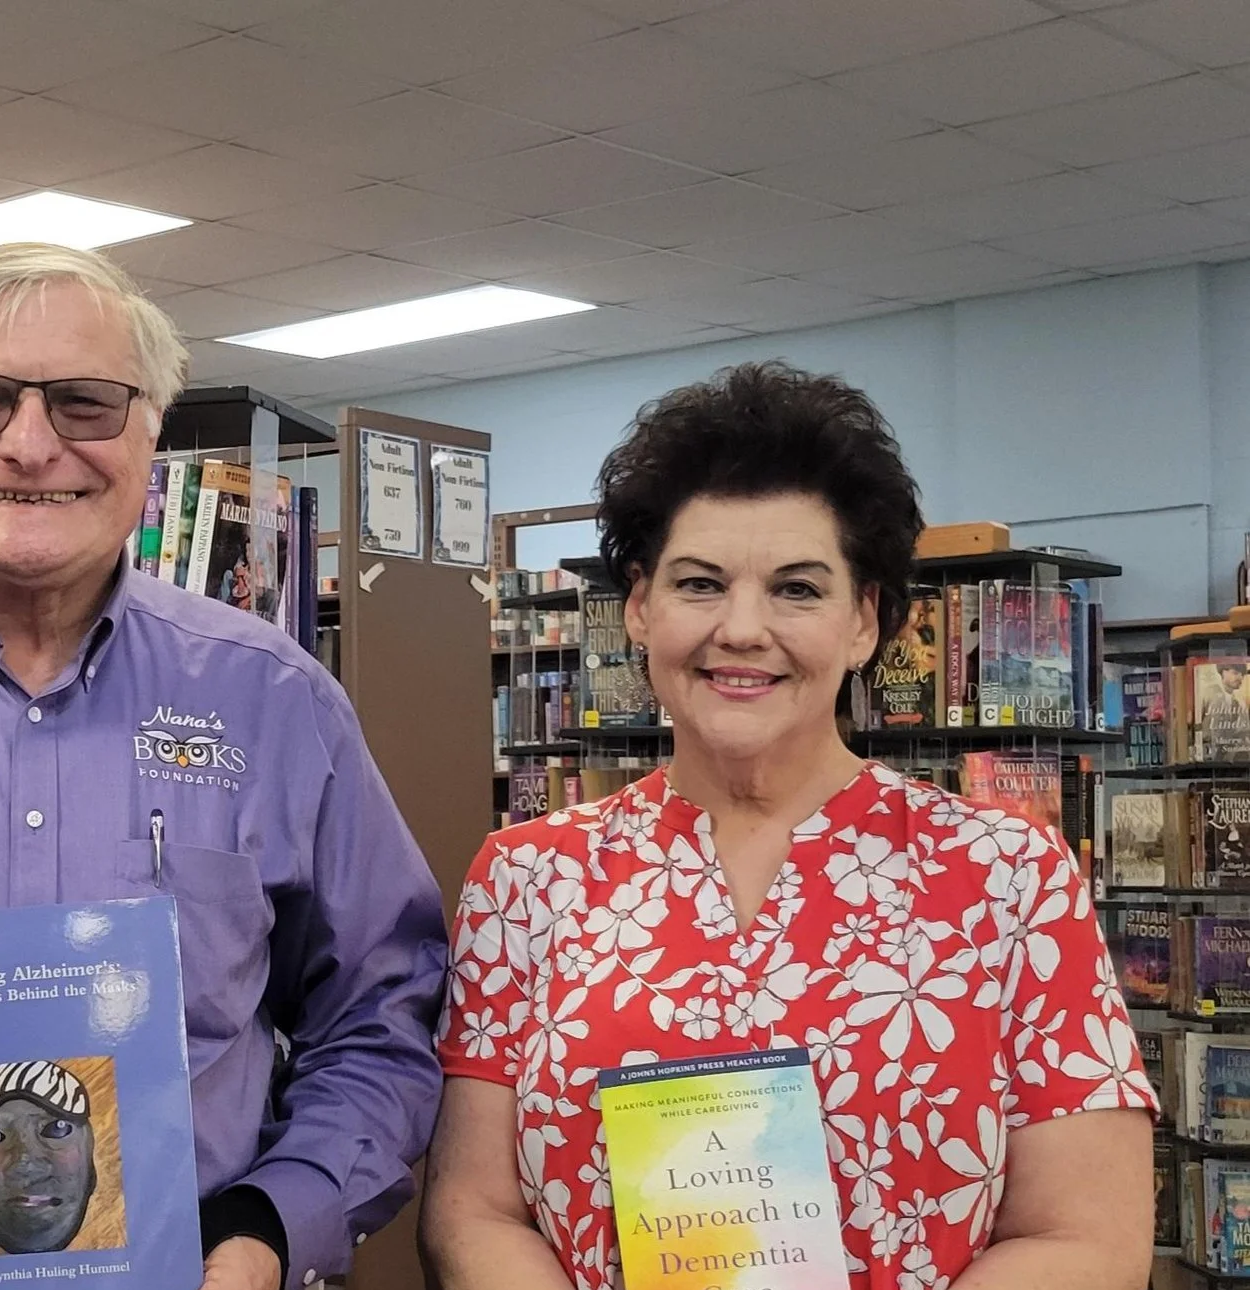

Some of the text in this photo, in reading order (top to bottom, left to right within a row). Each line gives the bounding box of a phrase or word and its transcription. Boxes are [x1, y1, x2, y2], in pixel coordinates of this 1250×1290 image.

[383, 485, 401, 499] 637
[873, 666, 930, 690] Deceive
[882, 689, 922, 704] KRESLEY
[140, 704, 226, 731] Nana's
[948, 710, 959, 722] C
[984, 708, 996, 721] C
[993, 761, 1058, 775] CATHERINE
[138, 766, 240, 792] FOUNDATION
[514, 777, 546, 795] TAMI
[995, 775, 1059, 792] COULTER
[512, 794, 549, 813] HOAG
[1127, 924, 1173, 939] WOODS
[12, 959, 122, 982] Alzheimer's:
[7, 985, 60, 1002] Behind
[63, 983, 88, 997] the
[91, 980, 138, 995] Masks
[619, 1054, 788, 1081] A JOHNS HOPKINS PRESS HEALTH BOOK
[614, 1083, 803, 1113] MAKING MEANINGFUL CONNECTIONS
[659, 1101, 760, 1119] WHILE CAREGIVING
[703, 1130, 727, 1153] A
[666, 1161, 776, 1192] Loving
[631, 1198, 822, 1241] Approach to
[659, 1240, 809, 1276] Dementia
[34, 1265, 77, 1281] Huling
[78, 1261, 132, 1277] Hummel
